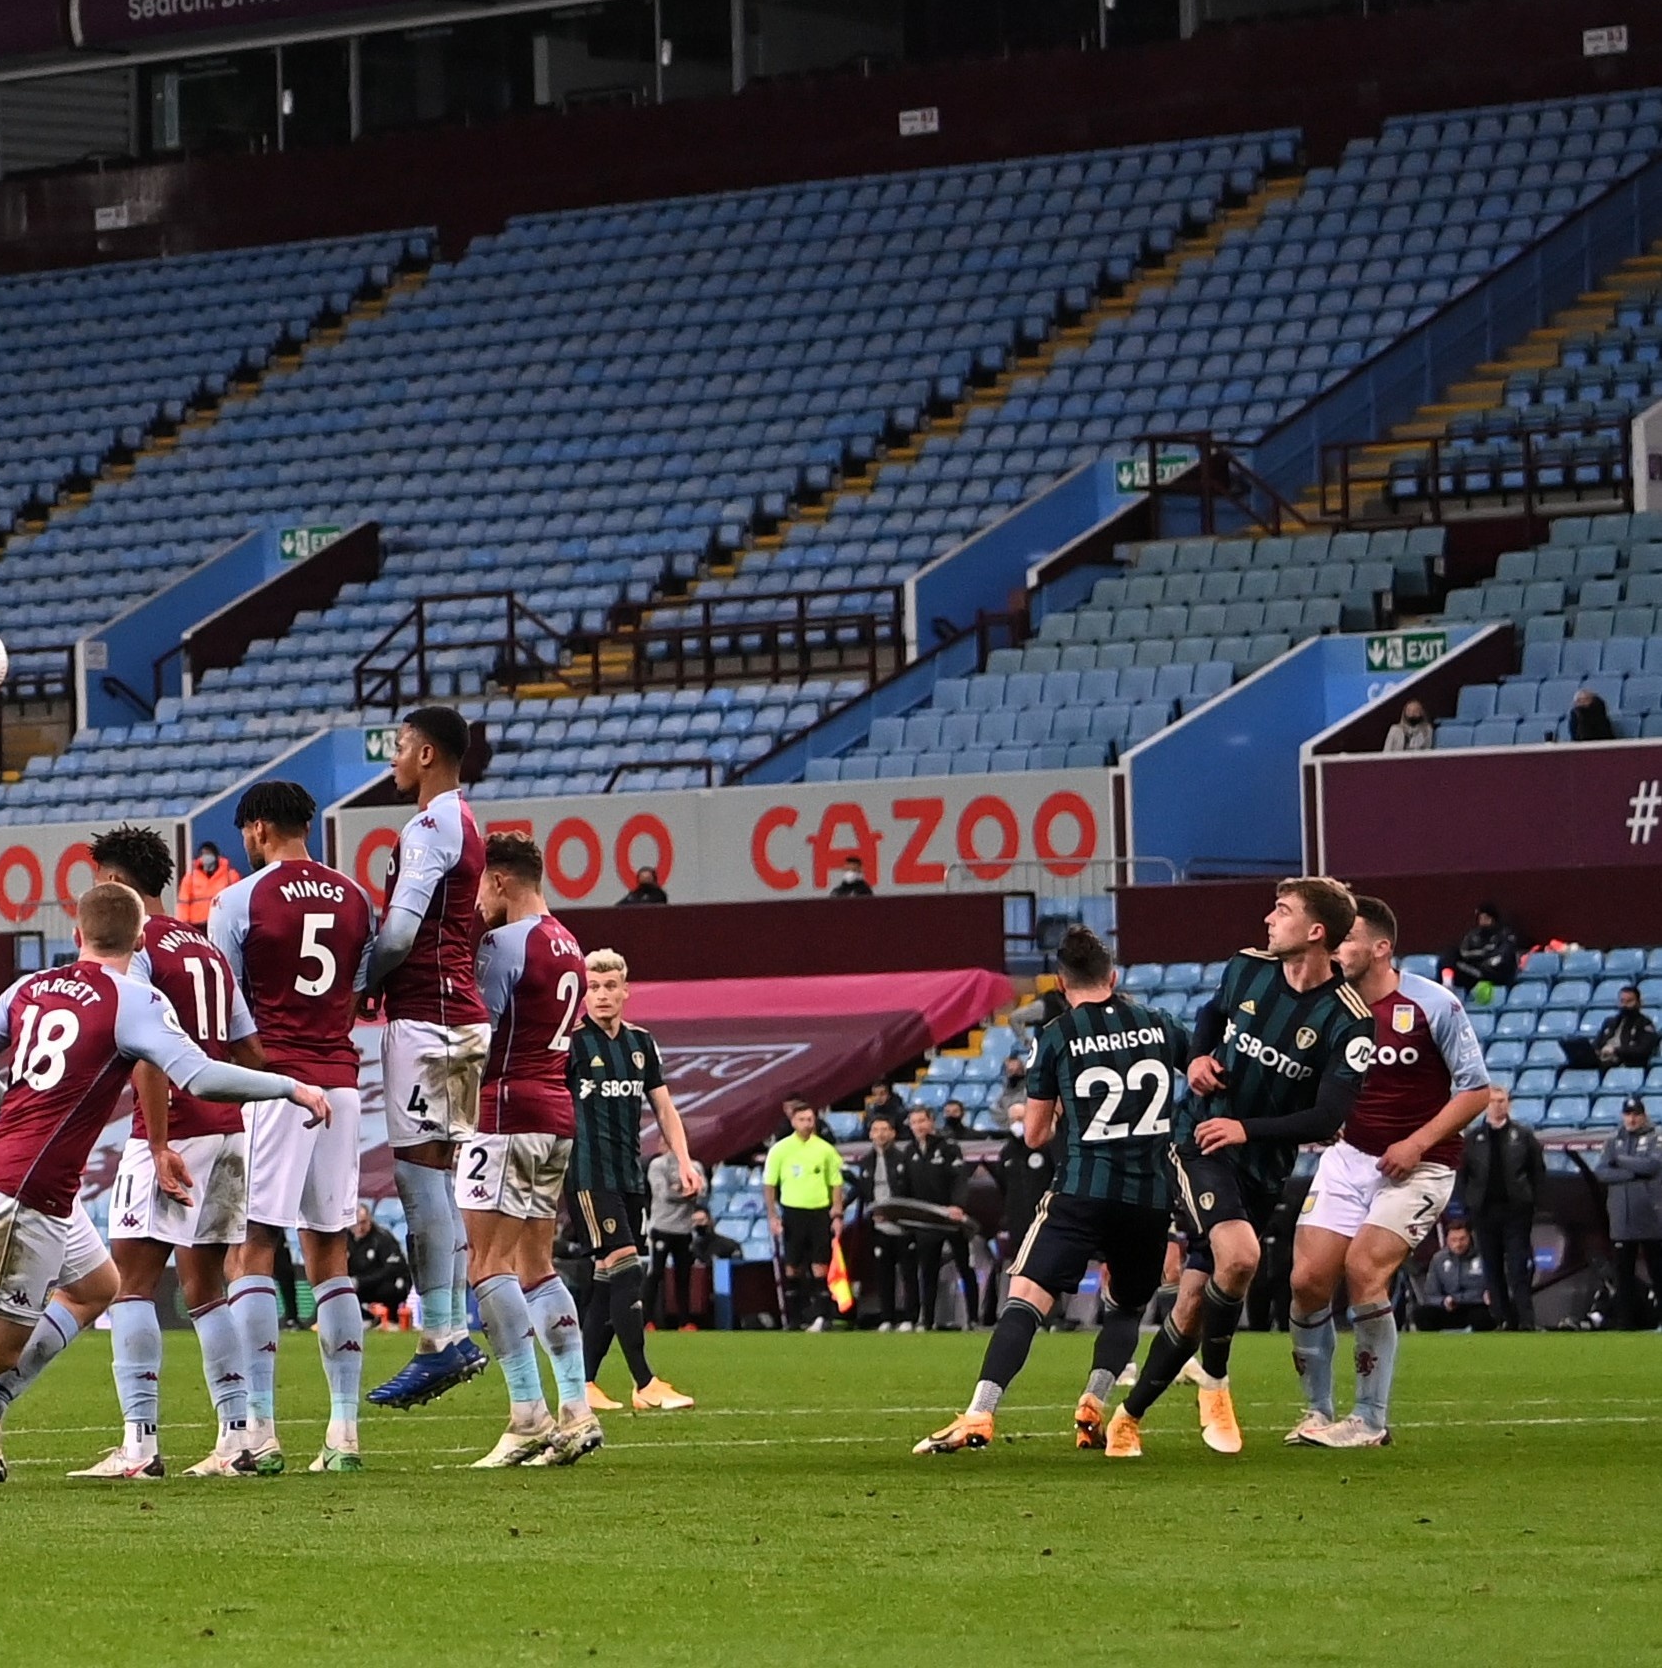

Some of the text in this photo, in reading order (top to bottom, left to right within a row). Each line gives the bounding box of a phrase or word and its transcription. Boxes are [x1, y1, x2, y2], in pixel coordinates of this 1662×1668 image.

[1406, 638, 1444, 662] EXIT
[751, 791, 1097, 890] CAZOO
[279, 880, 345, 903] MINGS
[294, 913, 336, 997] 5
[30, 978, 101, 1007] TARGETT
[183, 957, 227, 1041] 11
[547, 971, 580, 1051] 2
[11, 1004, 79, 1091] 18
[1069, 1027, 1165, 1057] HARRISON
[1235, 1033, 1314, 1082] SBOTOP
[407, 1085, 428, 1117] 4
[1075, 1059, 1171, 1141] 22
[467, 1147, 488, 1181] 2
[114, 1174, 134, 1209] 11
[1414, 1195, 1434, 1220] 7
